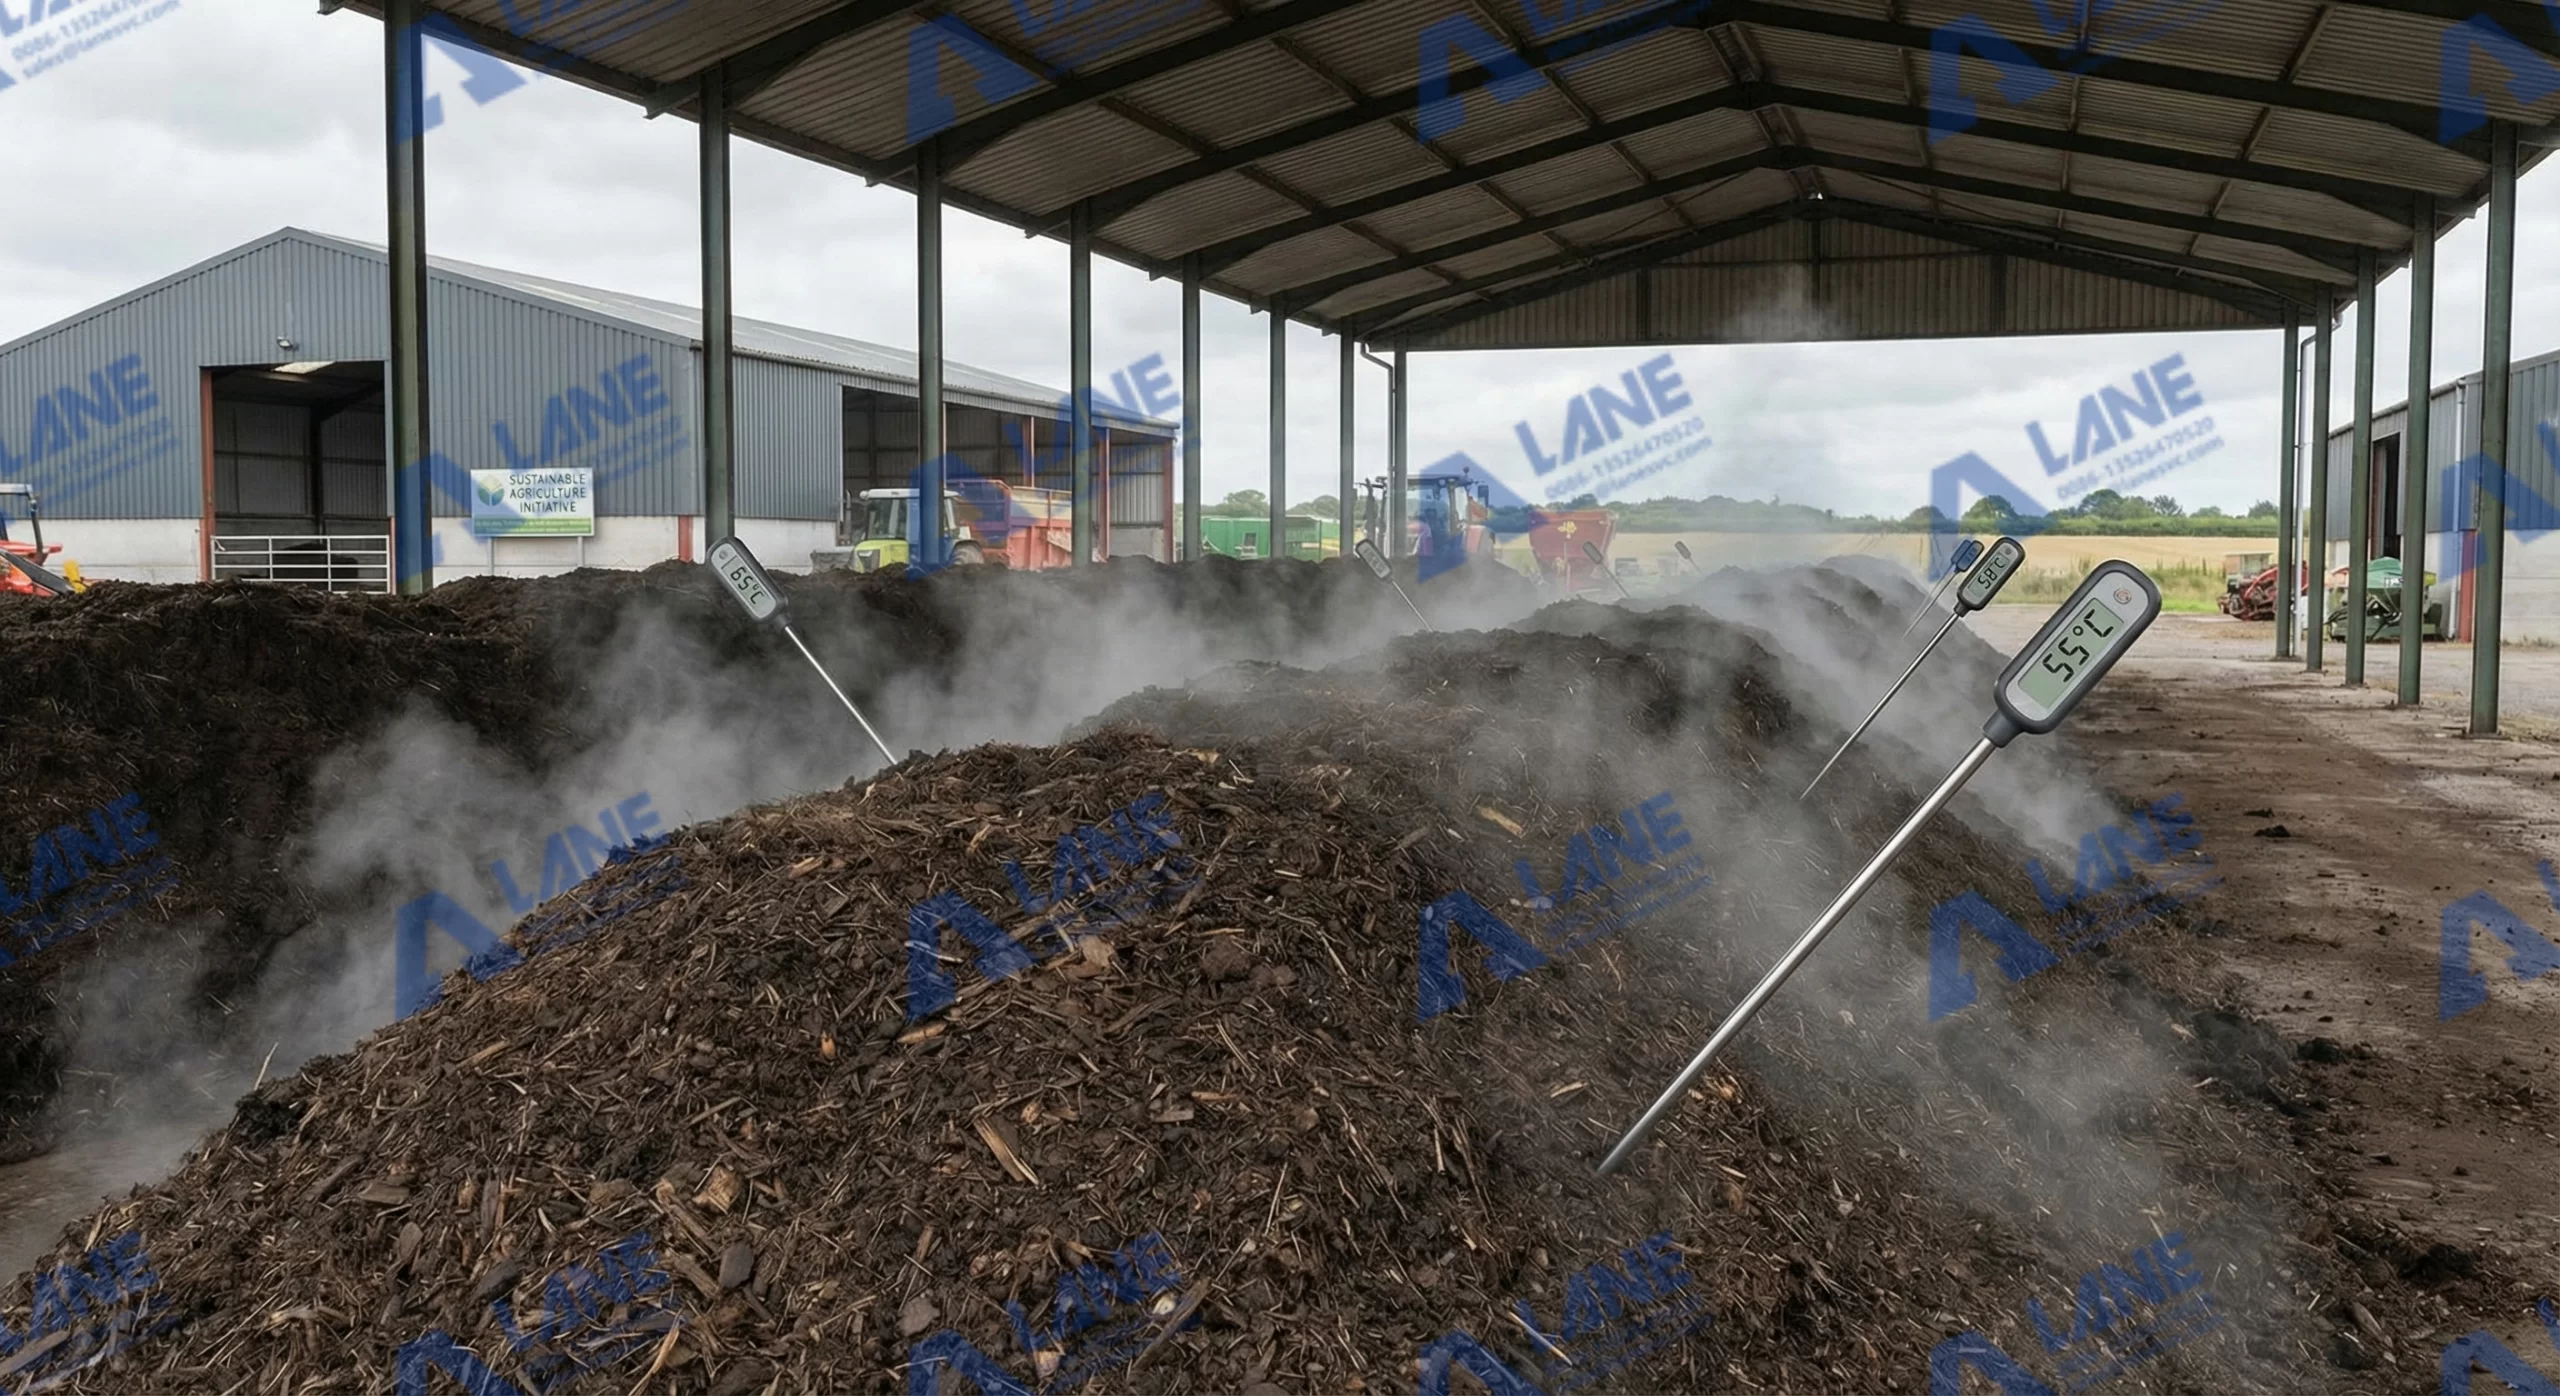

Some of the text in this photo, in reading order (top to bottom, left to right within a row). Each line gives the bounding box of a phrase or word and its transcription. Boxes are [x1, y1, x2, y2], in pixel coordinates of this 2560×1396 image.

[509, 473, 587, 485] SUSTAINABLE
[509, 487, 587, 499] AGRICULTURE
[520, 501, 577, 513] INITIATIVE
[730, 567, 765, 604] 65°C
[2043, 609, 2114, 683] 55°C
